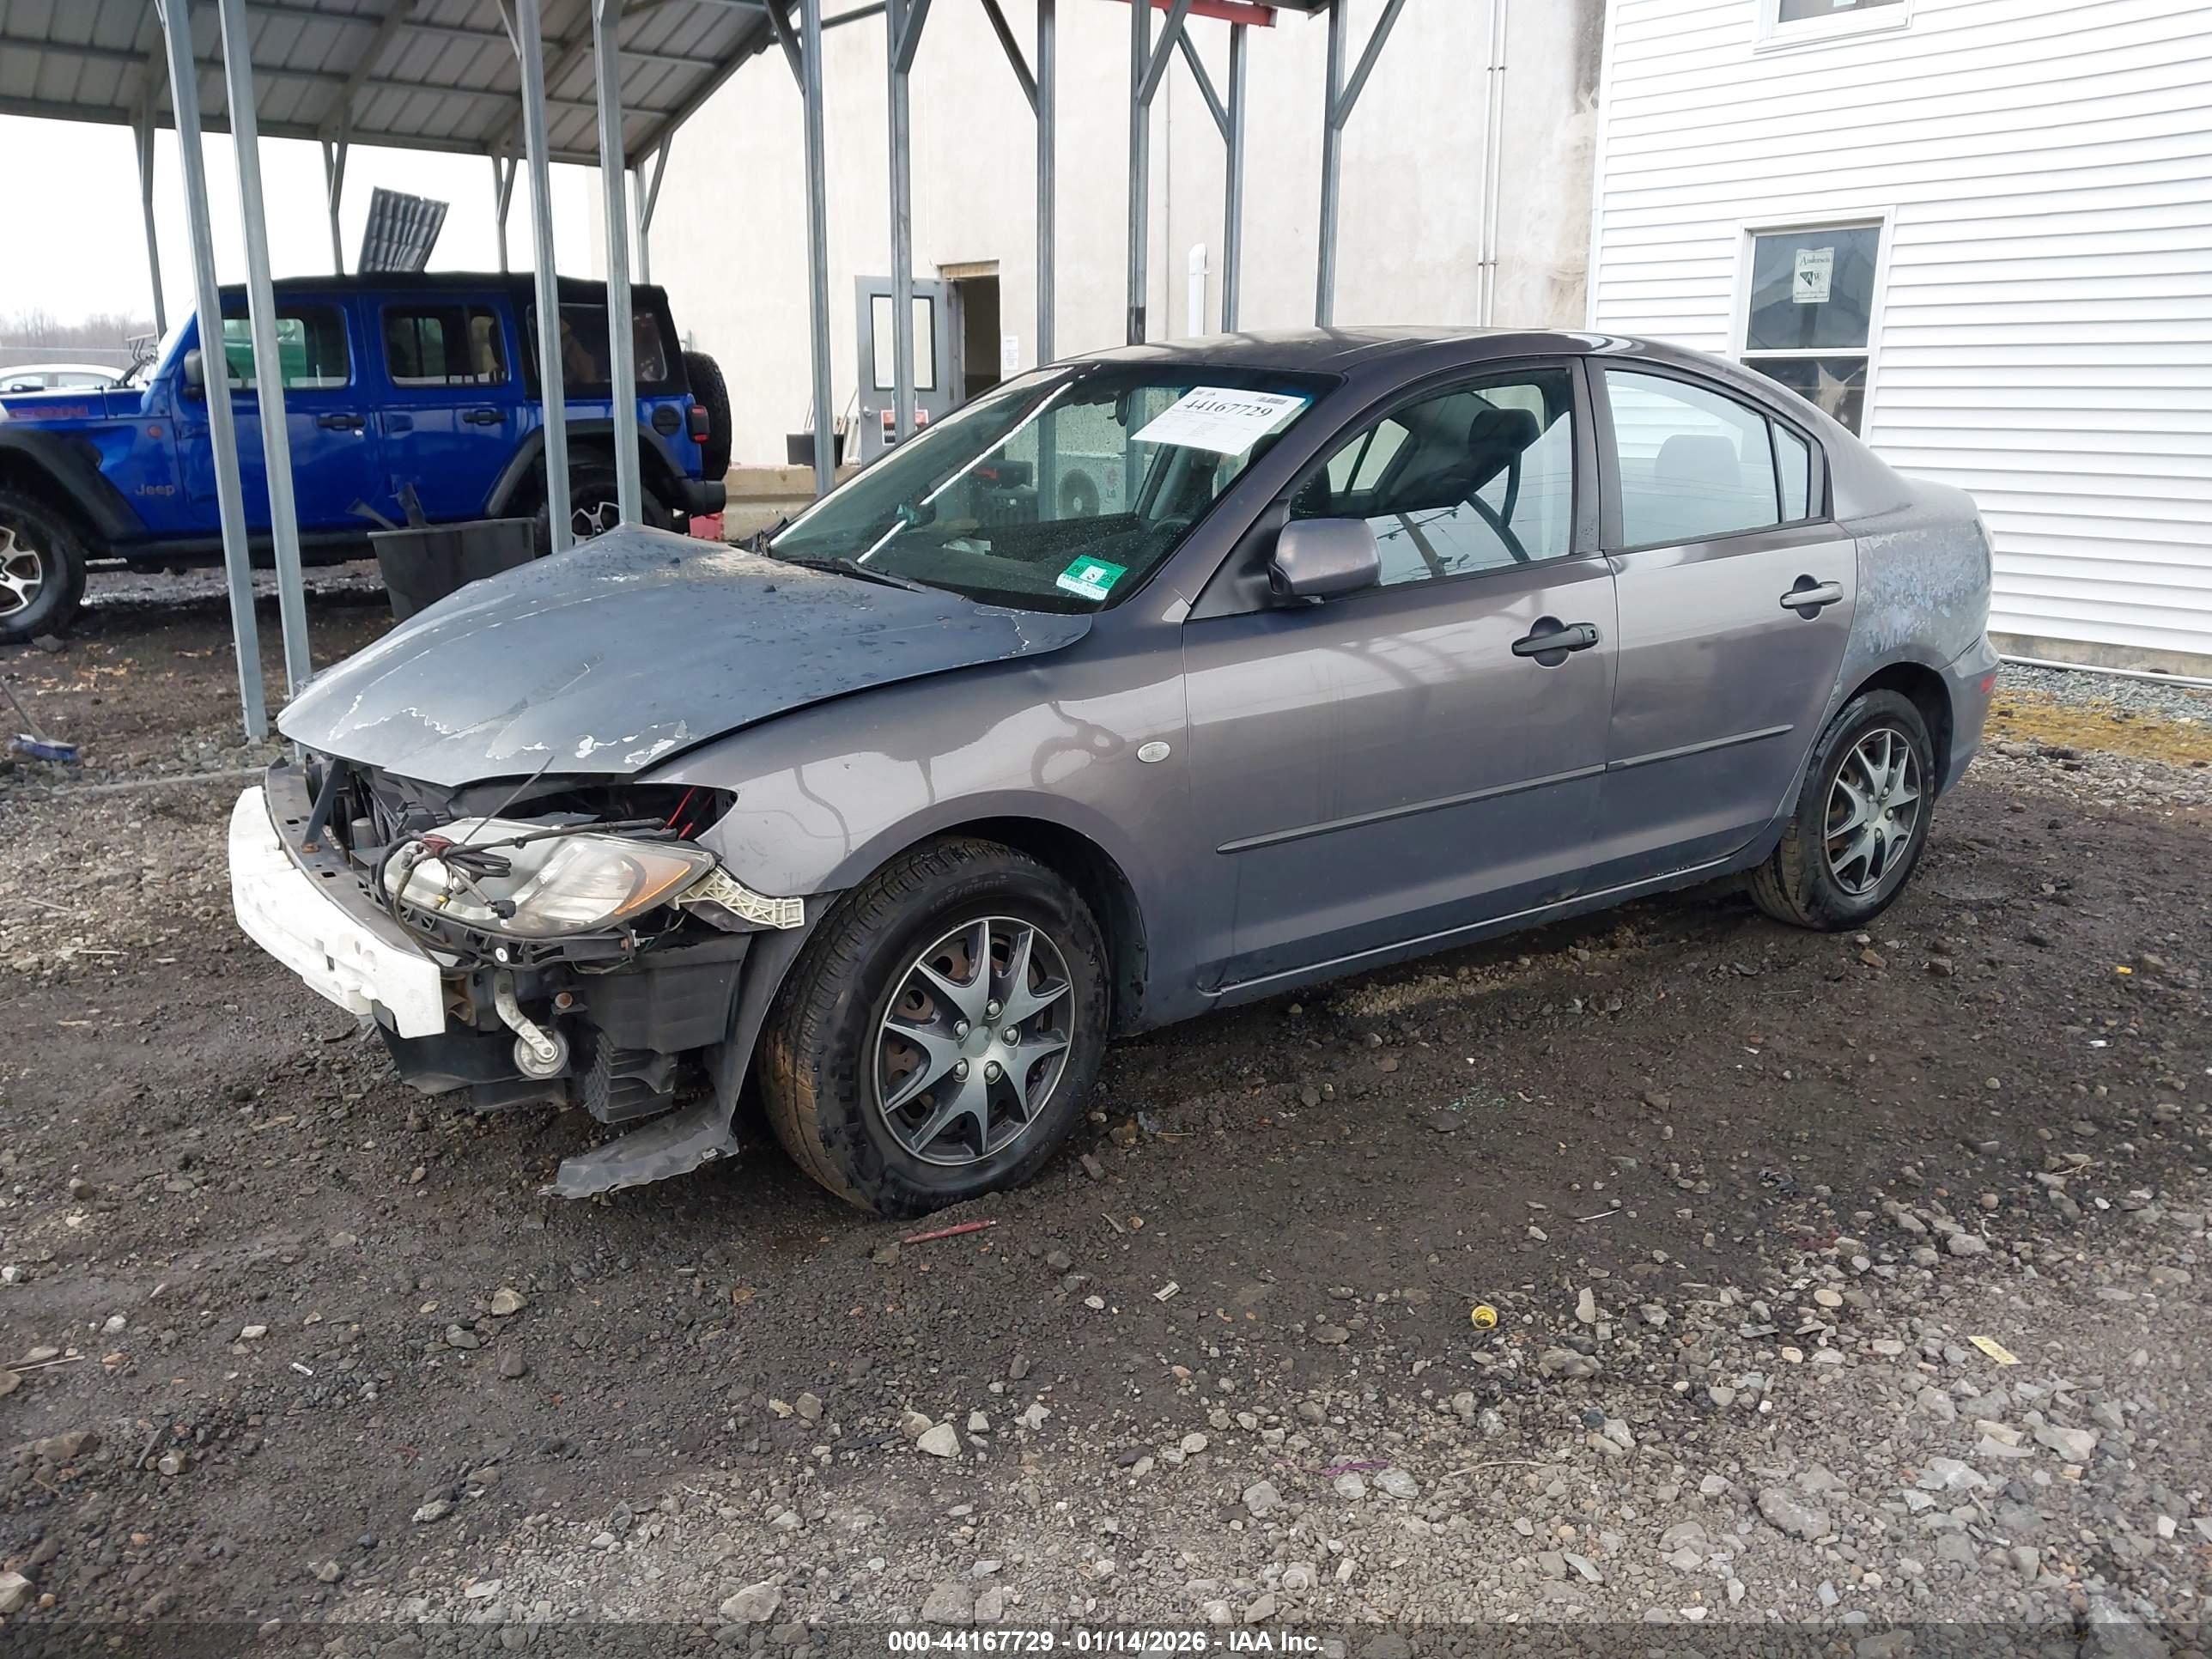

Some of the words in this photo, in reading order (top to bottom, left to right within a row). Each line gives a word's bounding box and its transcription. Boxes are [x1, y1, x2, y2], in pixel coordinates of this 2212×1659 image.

[1184, 398, 1273, 417] 44167729
[135, 483, 176, 496] Jeep
[1072, 564, 1084, 574] 20
[1101, 574, 1115, 583] 25
